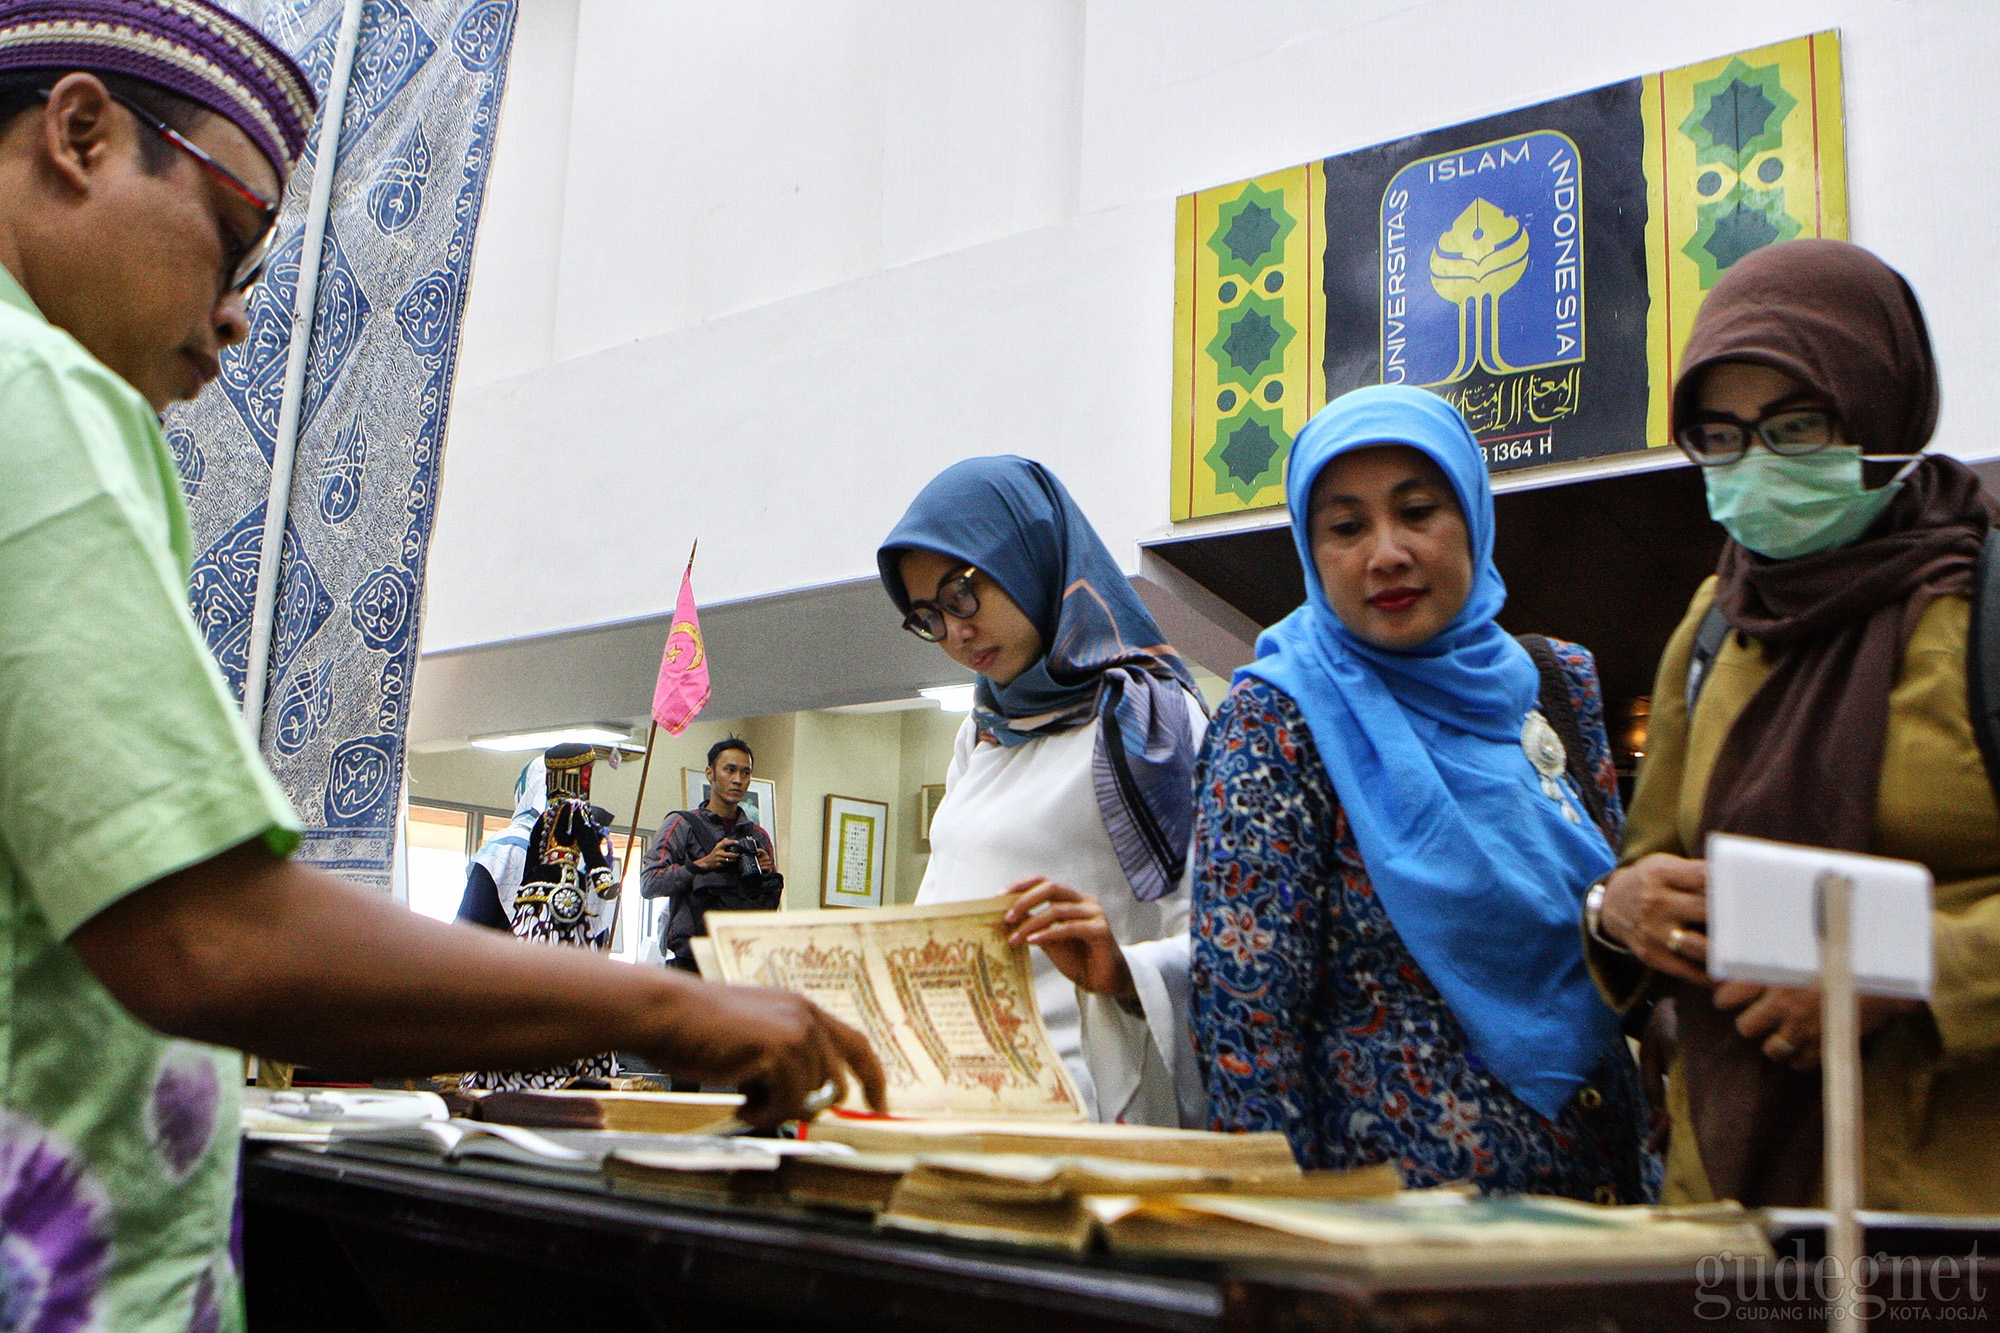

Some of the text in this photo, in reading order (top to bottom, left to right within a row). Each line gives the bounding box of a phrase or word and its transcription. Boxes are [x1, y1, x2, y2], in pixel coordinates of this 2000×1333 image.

[1387, 140, 1578, 385] UNIVERSITAS ISLAM INDONESIA
[1491, 439, 1533, 462] 1364
[1539, 436, 1552, 455] H
